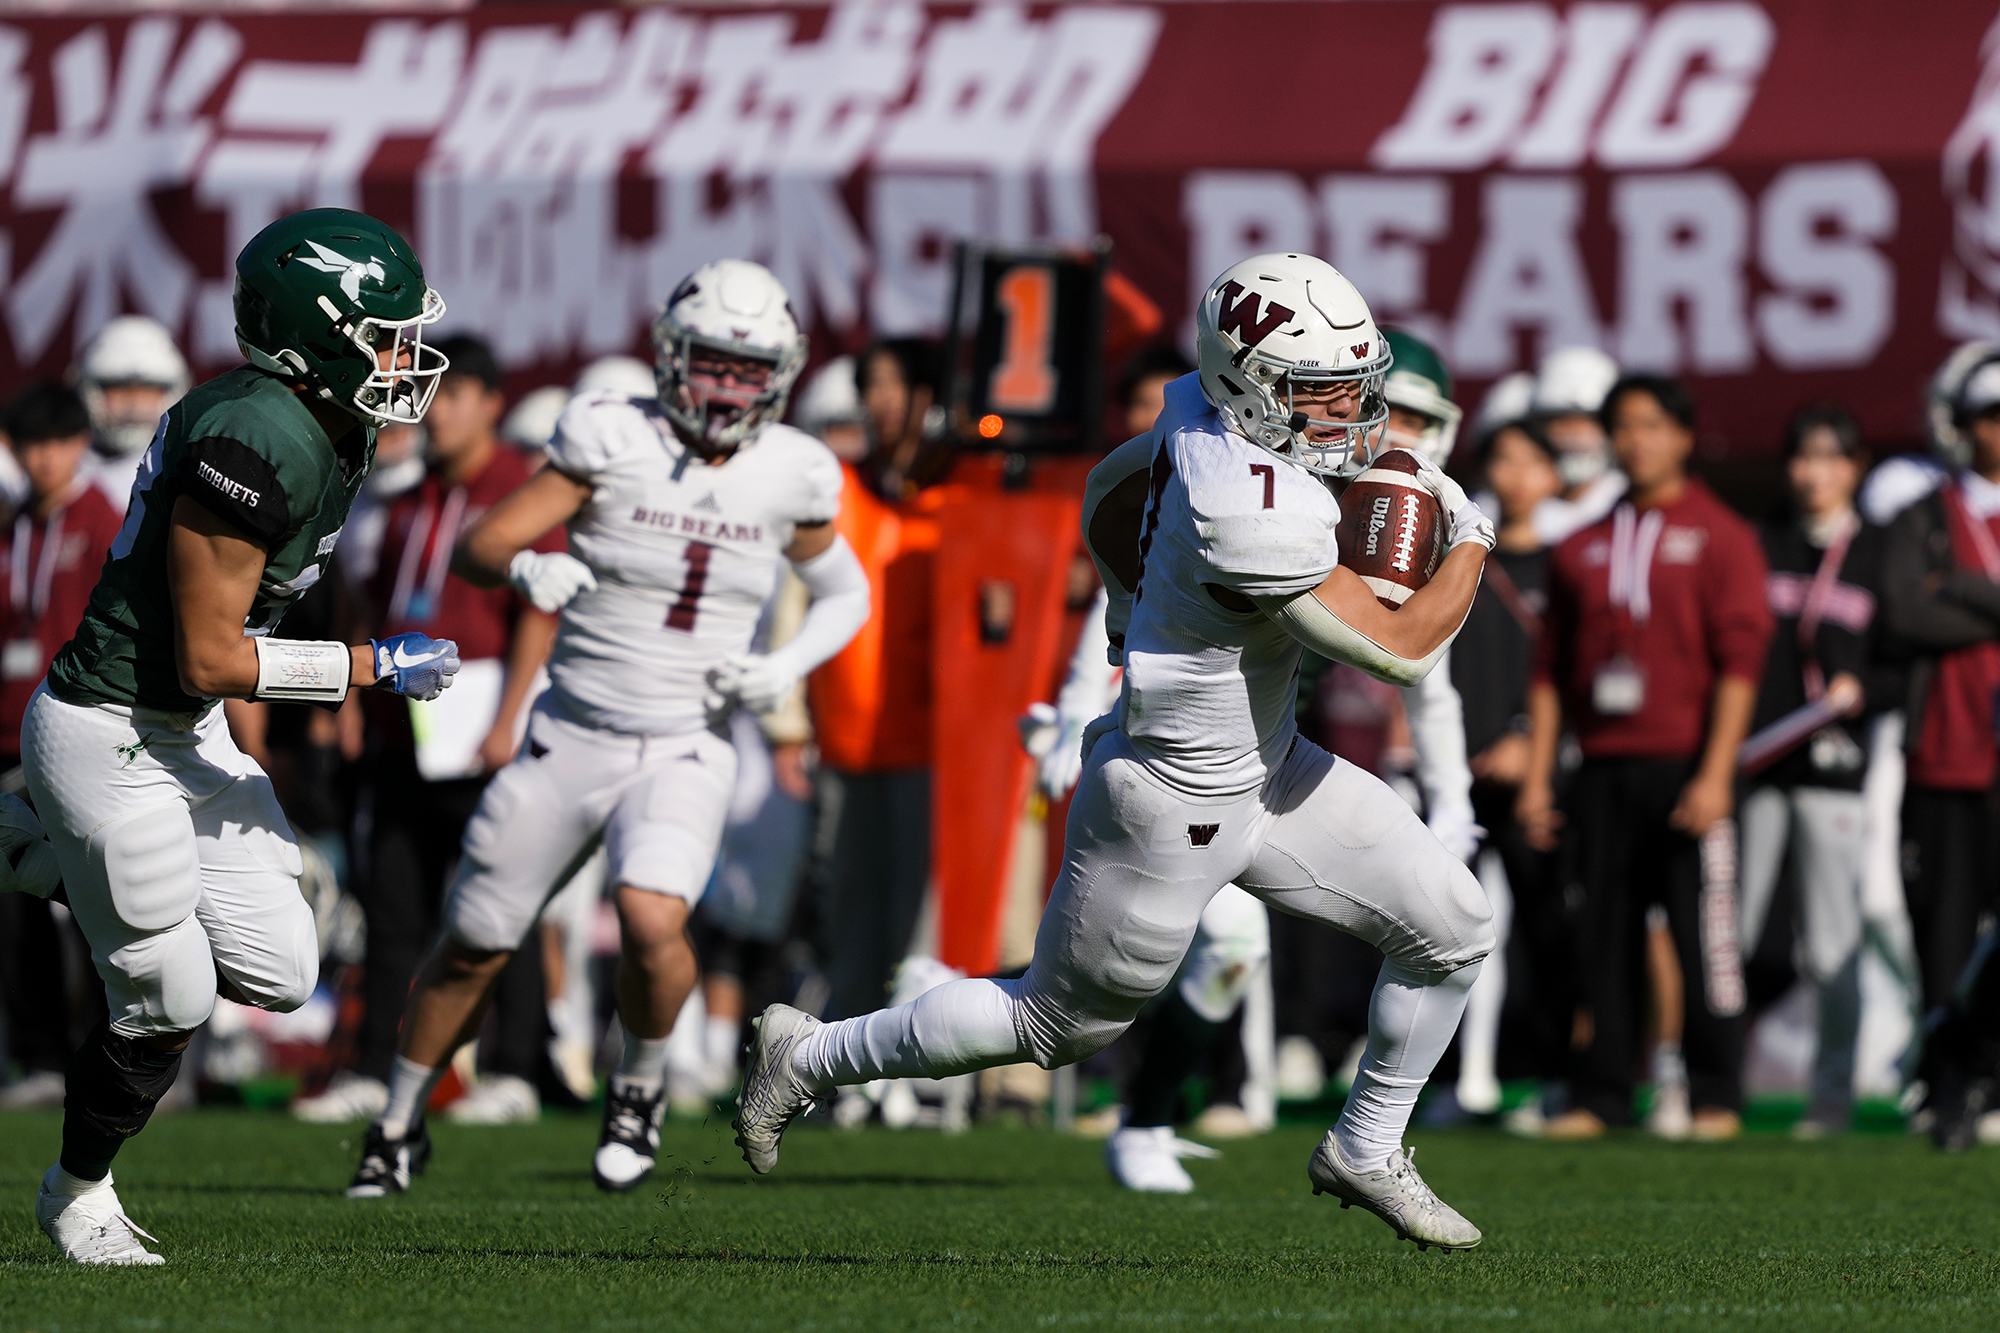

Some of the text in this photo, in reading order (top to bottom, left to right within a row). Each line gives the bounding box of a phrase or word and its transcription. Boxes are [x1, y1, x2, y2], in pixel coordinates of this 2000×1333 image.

[1372, 3, 1778, 170] BIG
[1218, 279, 1296, 348] W
[988, 265, 1058, 413] 1
[1350, 341, 1370, 360] W
[1299, 360, 1321, 368] FLEEK
[196, 460, 260, 507] HORNETS
[1248, 463, 1275, 510] 7
[631, 506, 676, 528] BIG
[680, 515, 764, 541] BEARS
[1365, 496, 1391, 556] Wilson
[663, 539, 716, 634] 1
[1186, 822, 1221, 847] W
